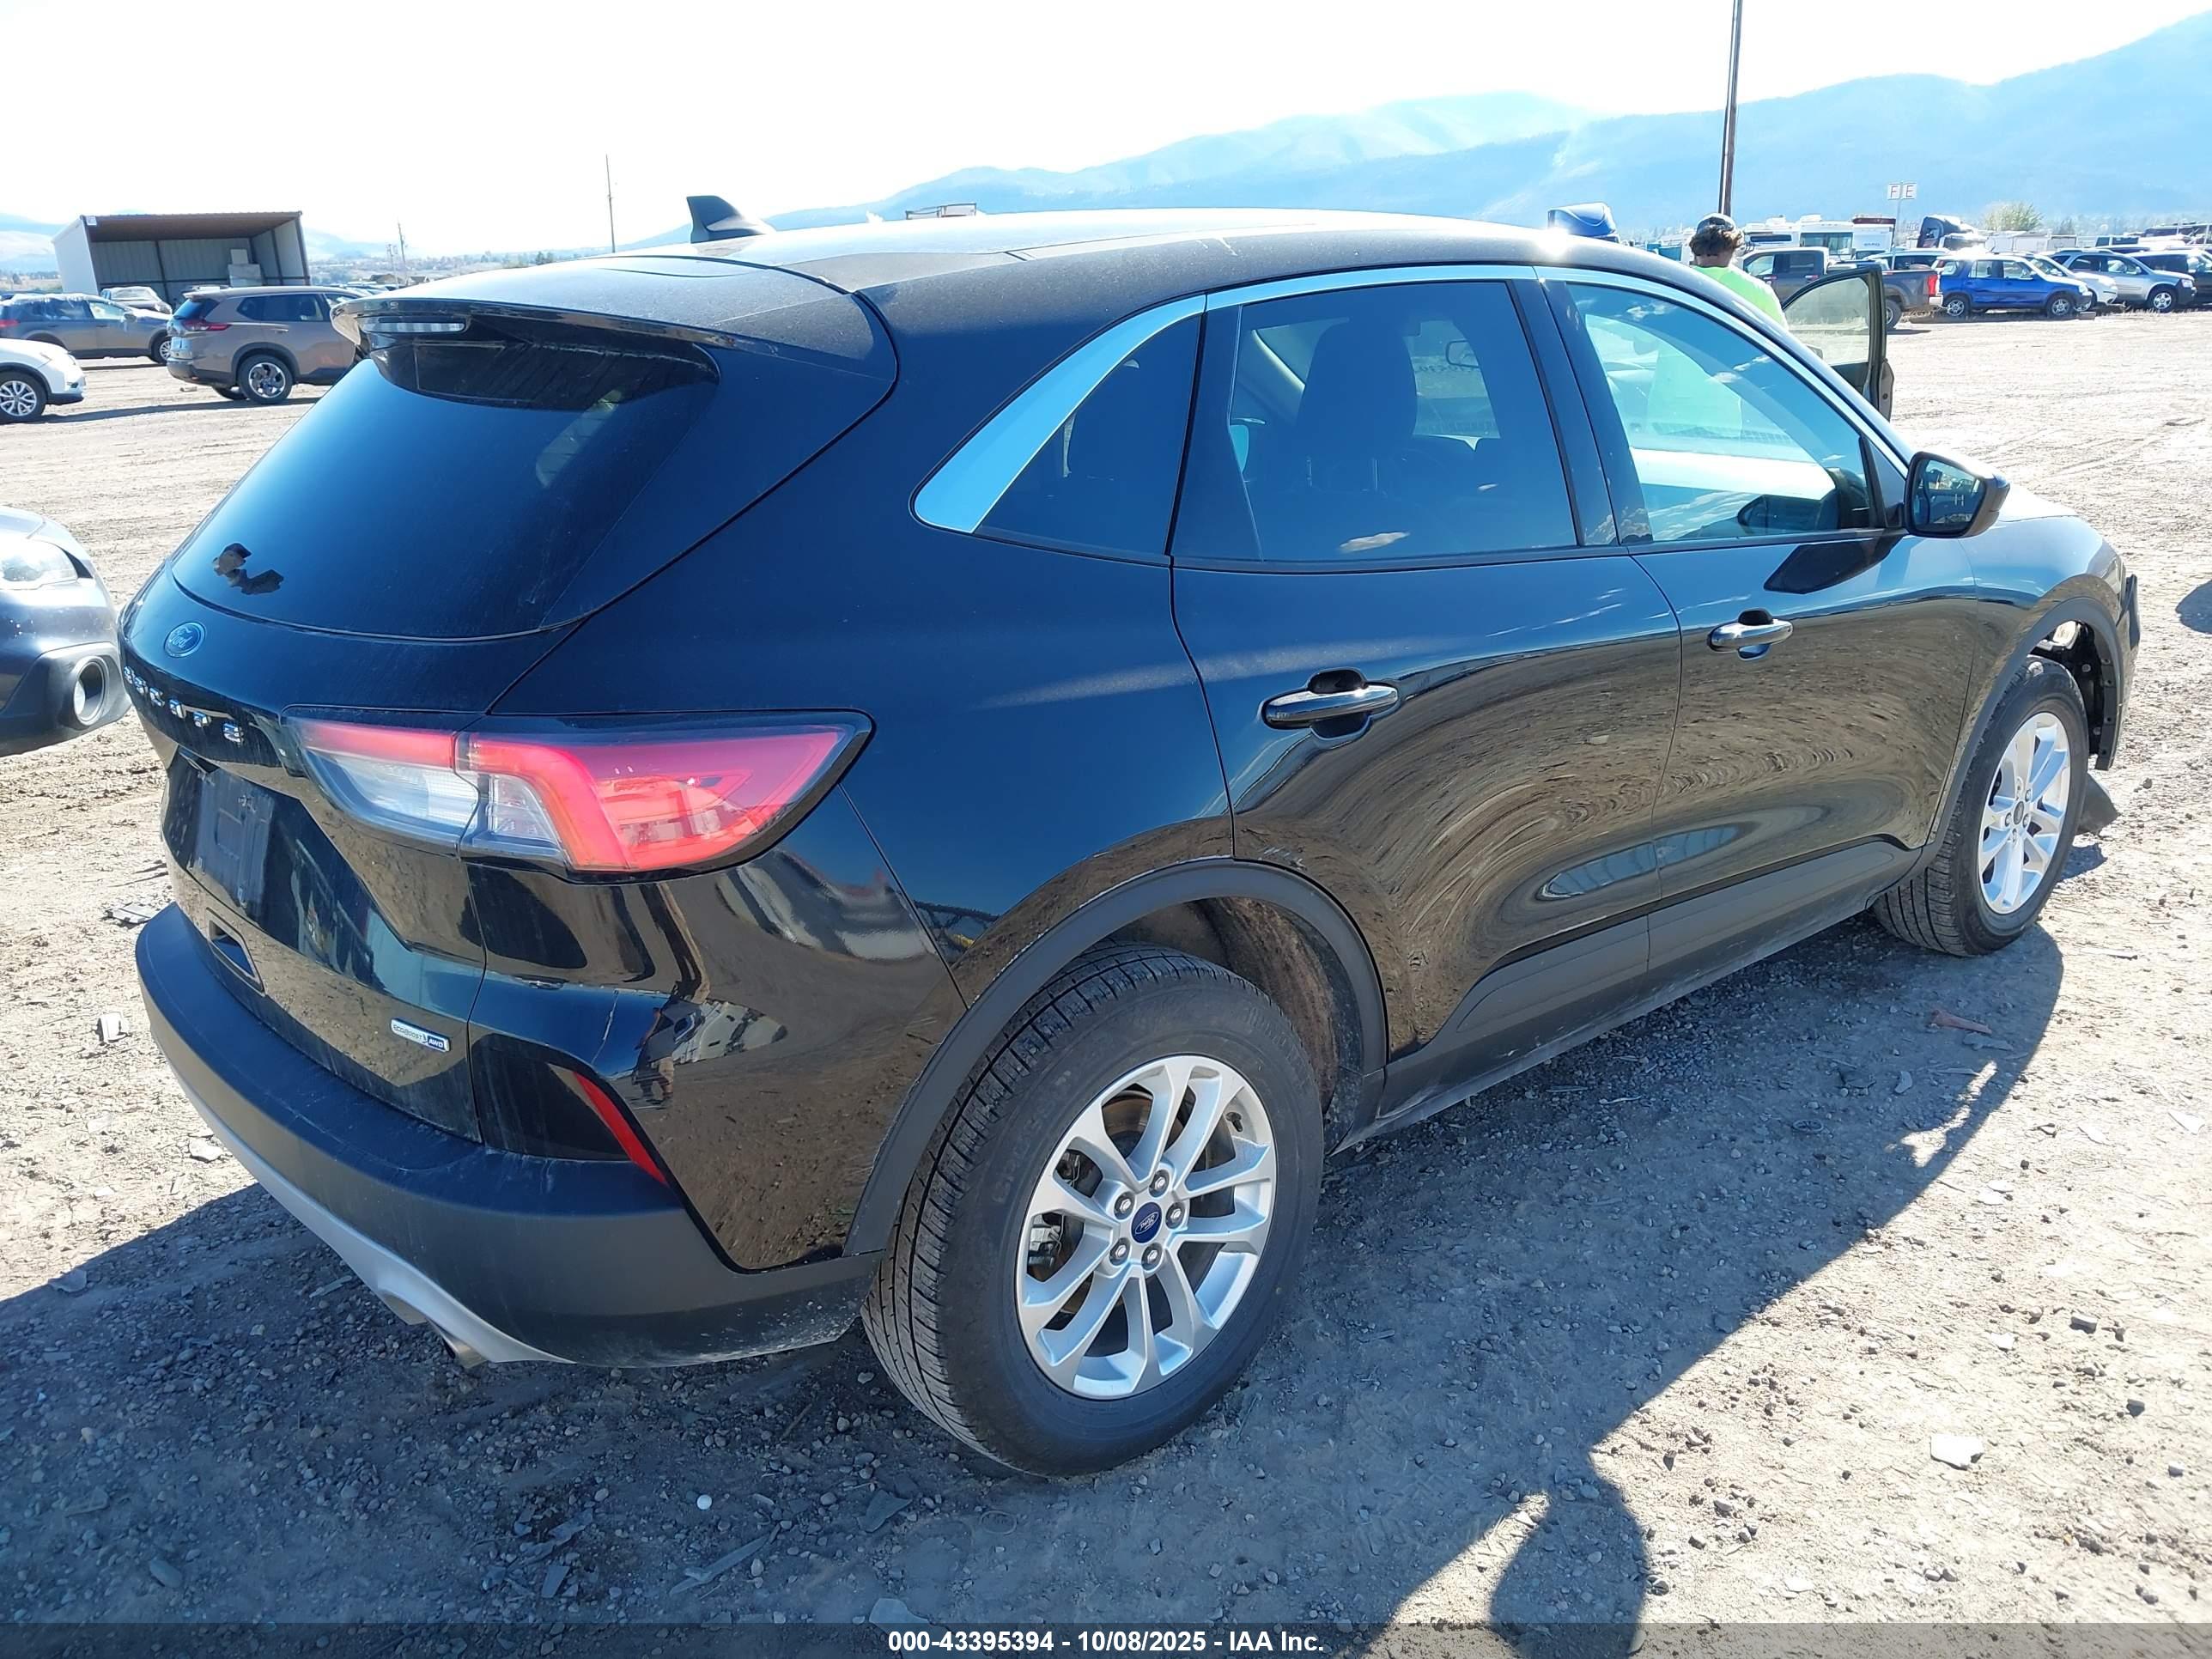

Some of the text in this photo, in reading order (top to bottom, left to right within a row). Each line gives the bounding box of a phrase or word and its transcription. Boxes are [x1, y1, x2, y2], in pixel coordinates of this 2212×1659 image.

[1890, 185, 1899, 198] F
[1905, 185, 1914, 198] E
[124, 665, 244, 745] ESCAPE
[428, 1038, 444, 1048] AWD
